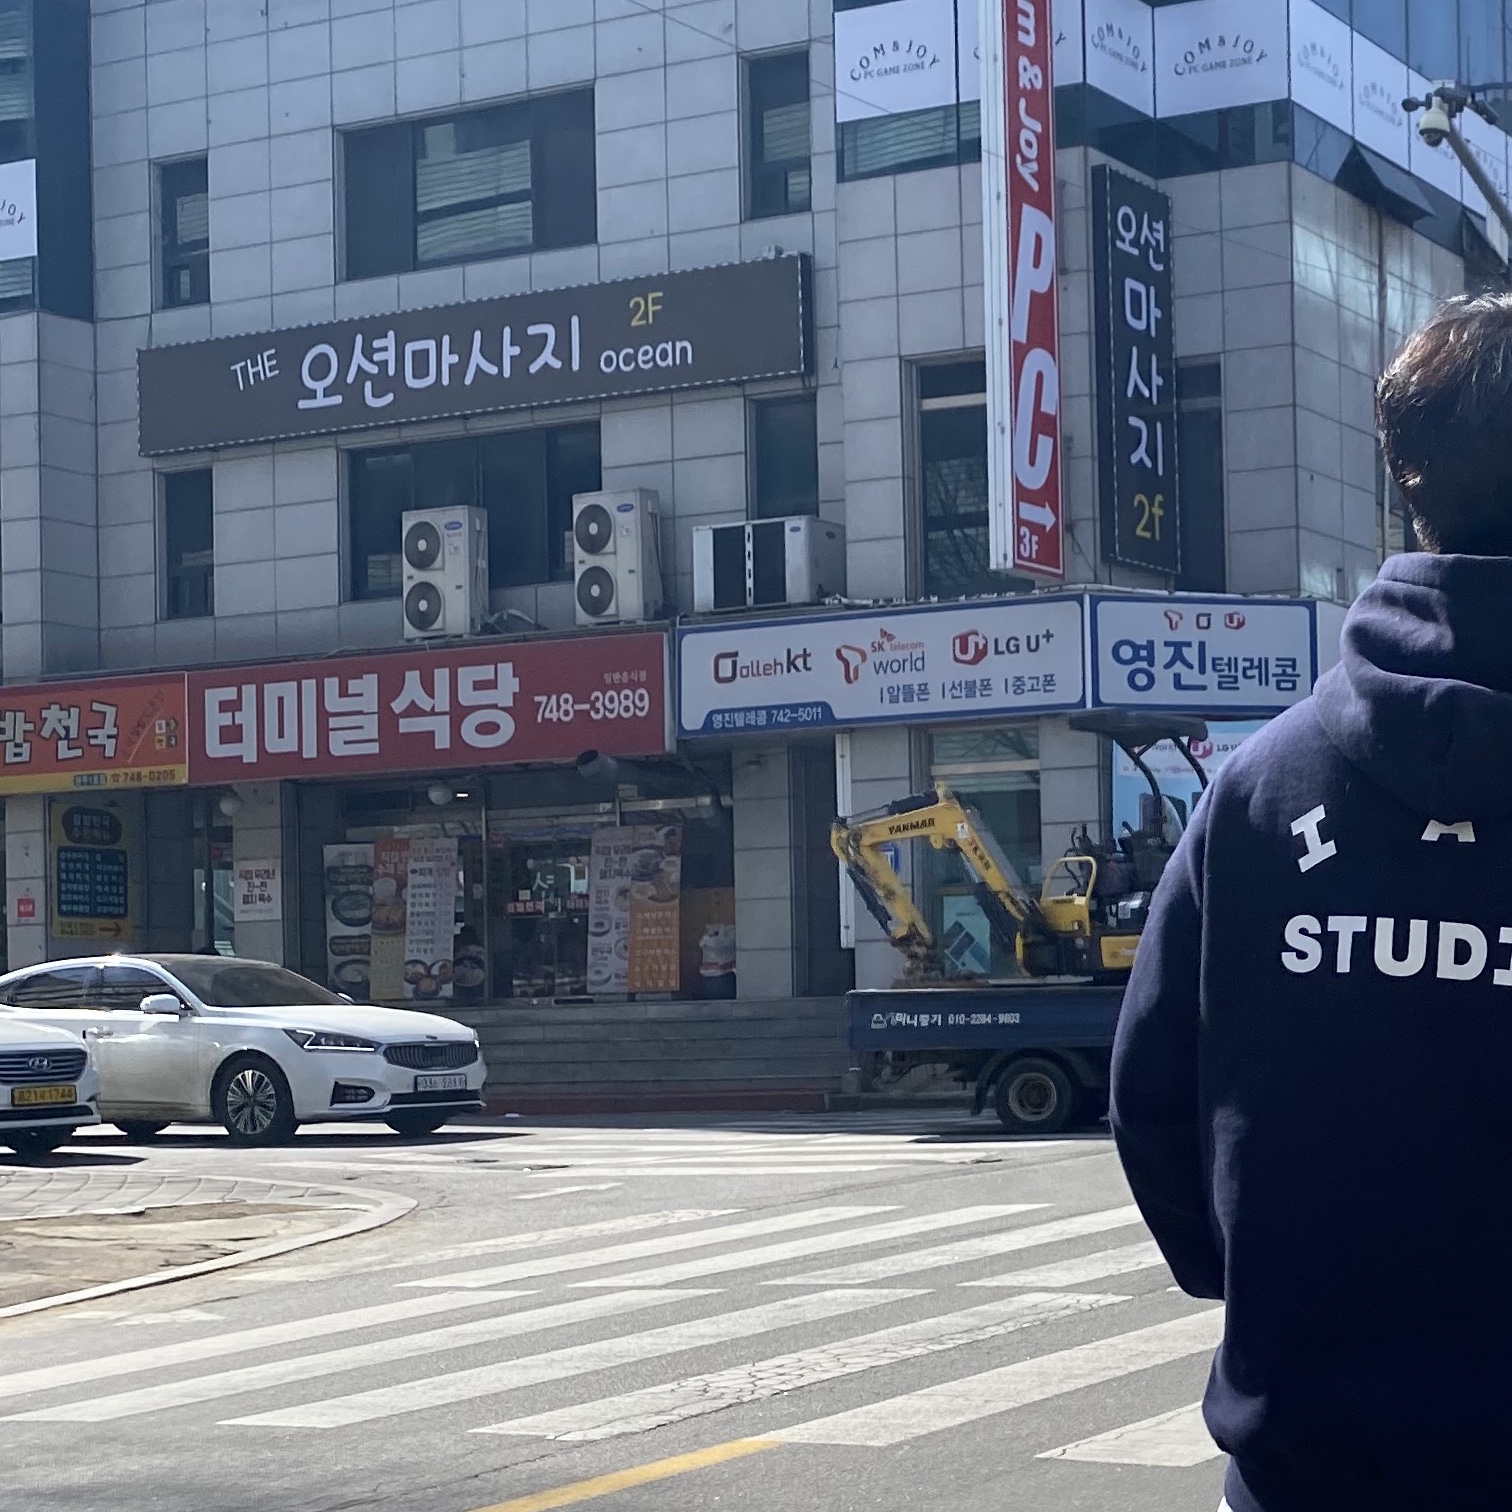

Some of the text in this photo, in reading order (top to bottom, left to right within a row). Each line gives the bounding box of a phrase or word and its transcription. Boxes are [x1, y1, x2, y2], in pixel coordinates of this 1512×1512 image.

[629, 291, 664, 328] 2F
[230, 314, 693, 410] THE 오션마사지 ocean
[1012, 203, 1056, 491] PC
[1019, 524, 1039, 559] 3F
[873, 651, 926, 675] world
[994, 636, 1021, 656] LG
[1011, 673, 1057, 696] 중고폰
[534, 687, 650, 723] 748-3989
